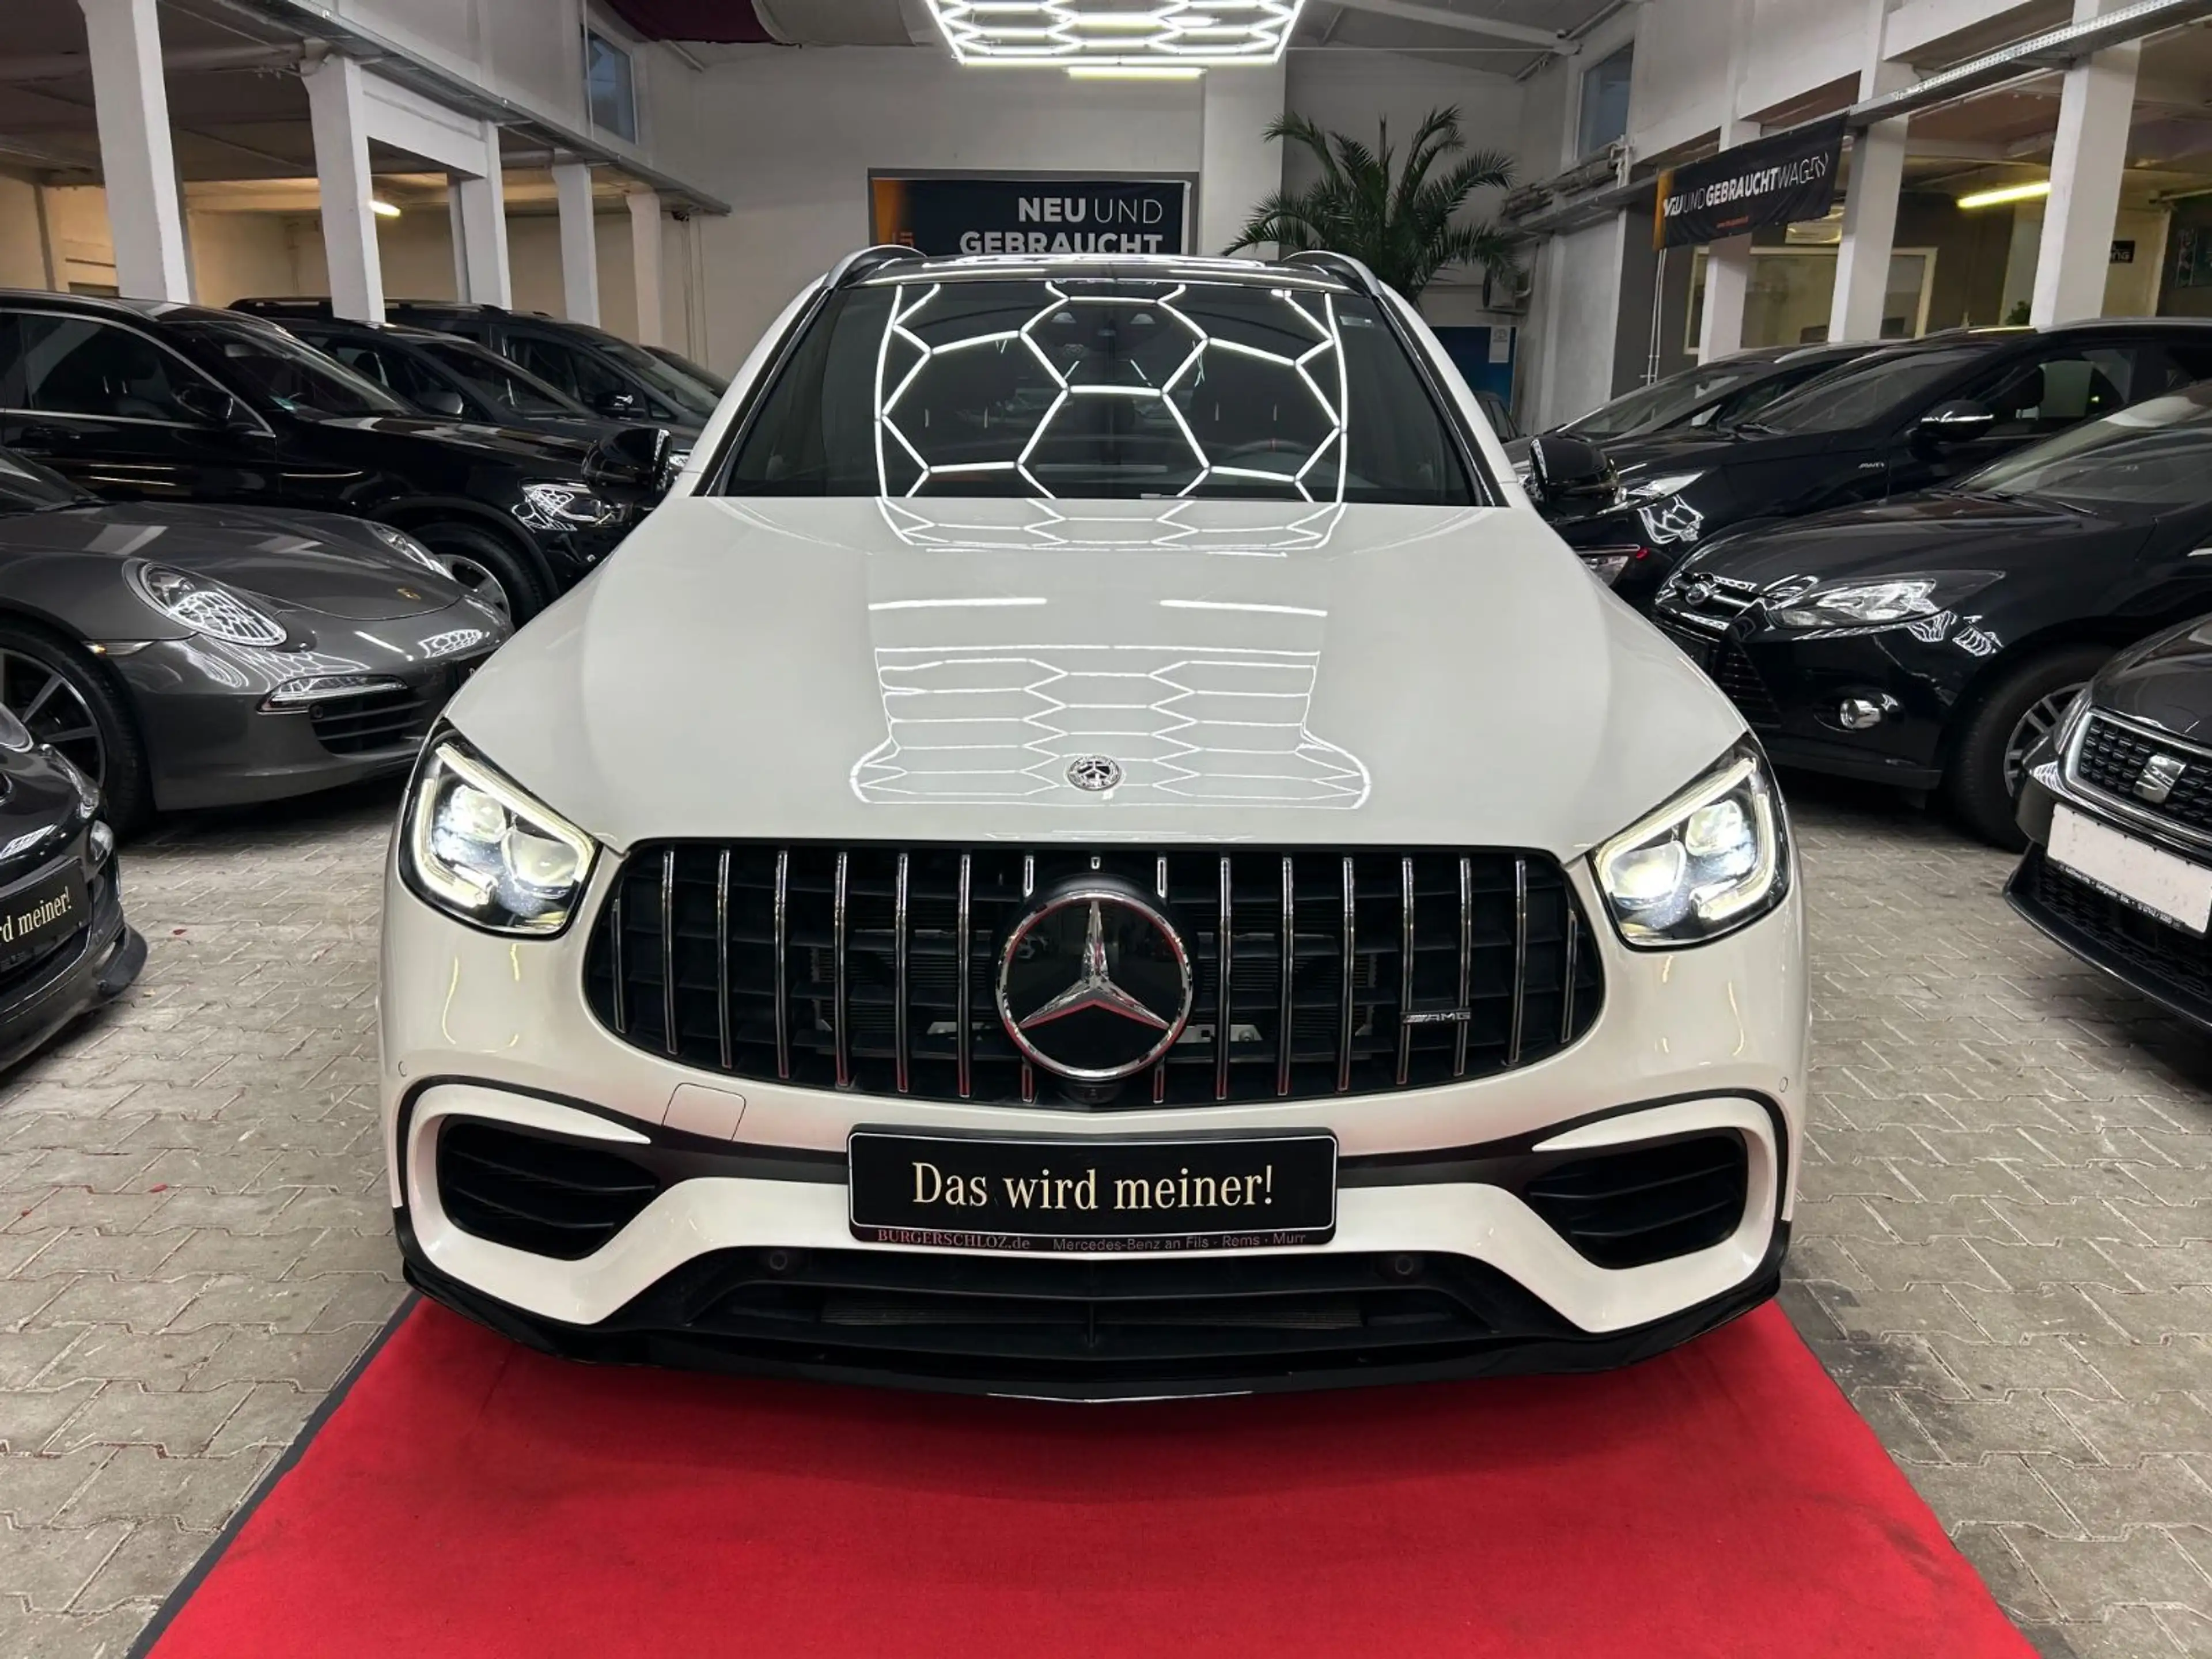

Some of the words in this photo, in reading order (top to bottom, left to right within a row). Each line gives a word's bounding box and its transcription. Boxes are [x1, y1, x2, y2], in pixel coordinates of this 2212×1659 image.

[1018, 197, 1086, 222] NEU
[1094, 199, 1162, 224] UND
[959, 231, 1163, 255] GEBRAUCHT
[18, 885, 72, 936] meiner!
[1424, 1012, 1471, 1022] AMG
[912, 1162, 987, 1207] Das
[1003, 1168, 1099, 1210] wird
[1114, 1165, 1274, 1209] meiner!
[1053, 1237, 1160, 1251] Mercedes-Benz
[1165, 1239, 1181, 1250] an
[1186, 1235, 1209, 1249] Fils
[1222, 1234, 1260, 1247] Rems
[1273, 1232, 1306, 1245] Murr
